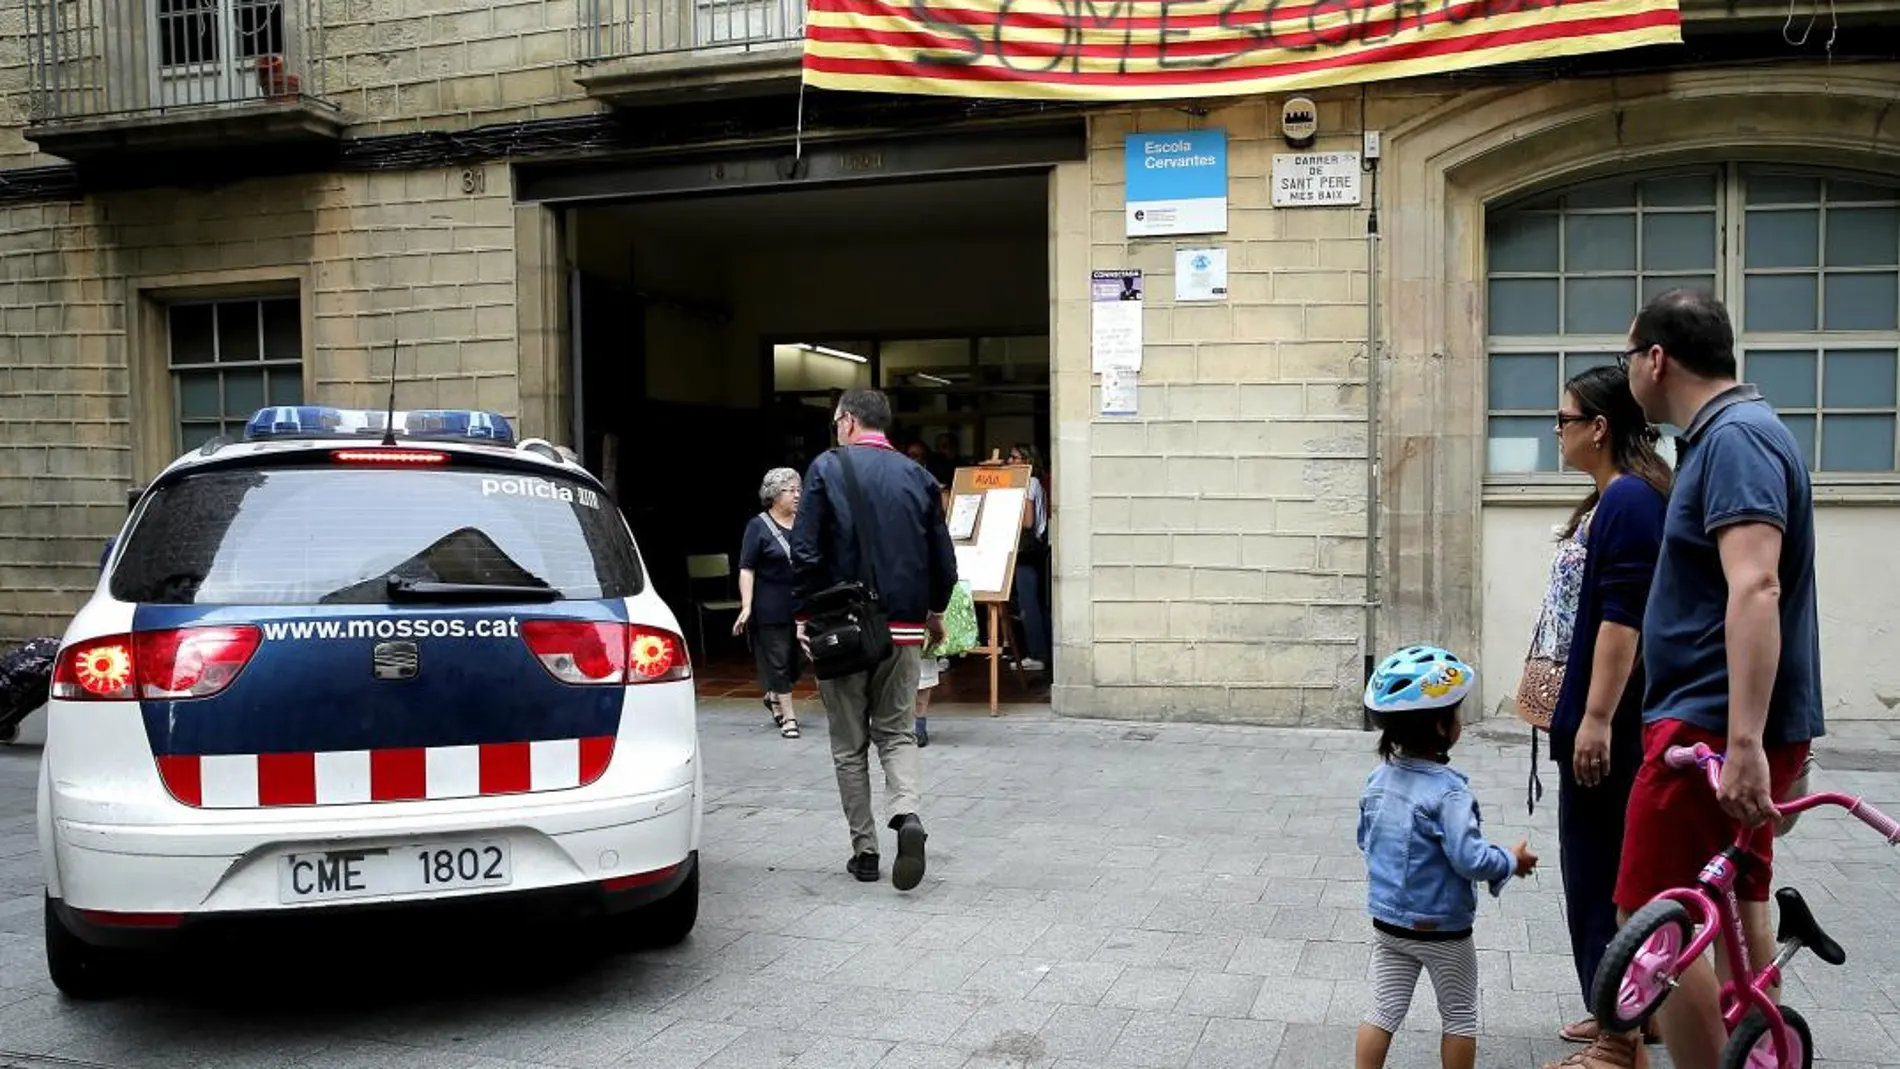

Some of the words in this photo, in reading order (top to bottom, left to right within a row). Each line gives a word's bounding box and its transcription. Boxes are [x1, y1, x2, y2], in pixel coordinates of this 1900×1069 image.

[912, 0, 1135, 74] SOM
[1144, 140, 1192, 155] Escola
[1144, 154, 1216, 169] Cervantes
[1294, 156, 1339, 166] CARRER
[1309, 166, 1324, 176] DE
[461, 168, 486, 195] 31
[1281, 177, 1313, 190] SANT
[1320, 176, 1352, 189] PERE
[1318, 190, 1342, 200] BAIX
[482, 477, 574, 503] policia
[263, 616, 519, 641] www.mossos.cat
[292, 856, 367, 895] CME
[418, 846, 503, 884] 1802
